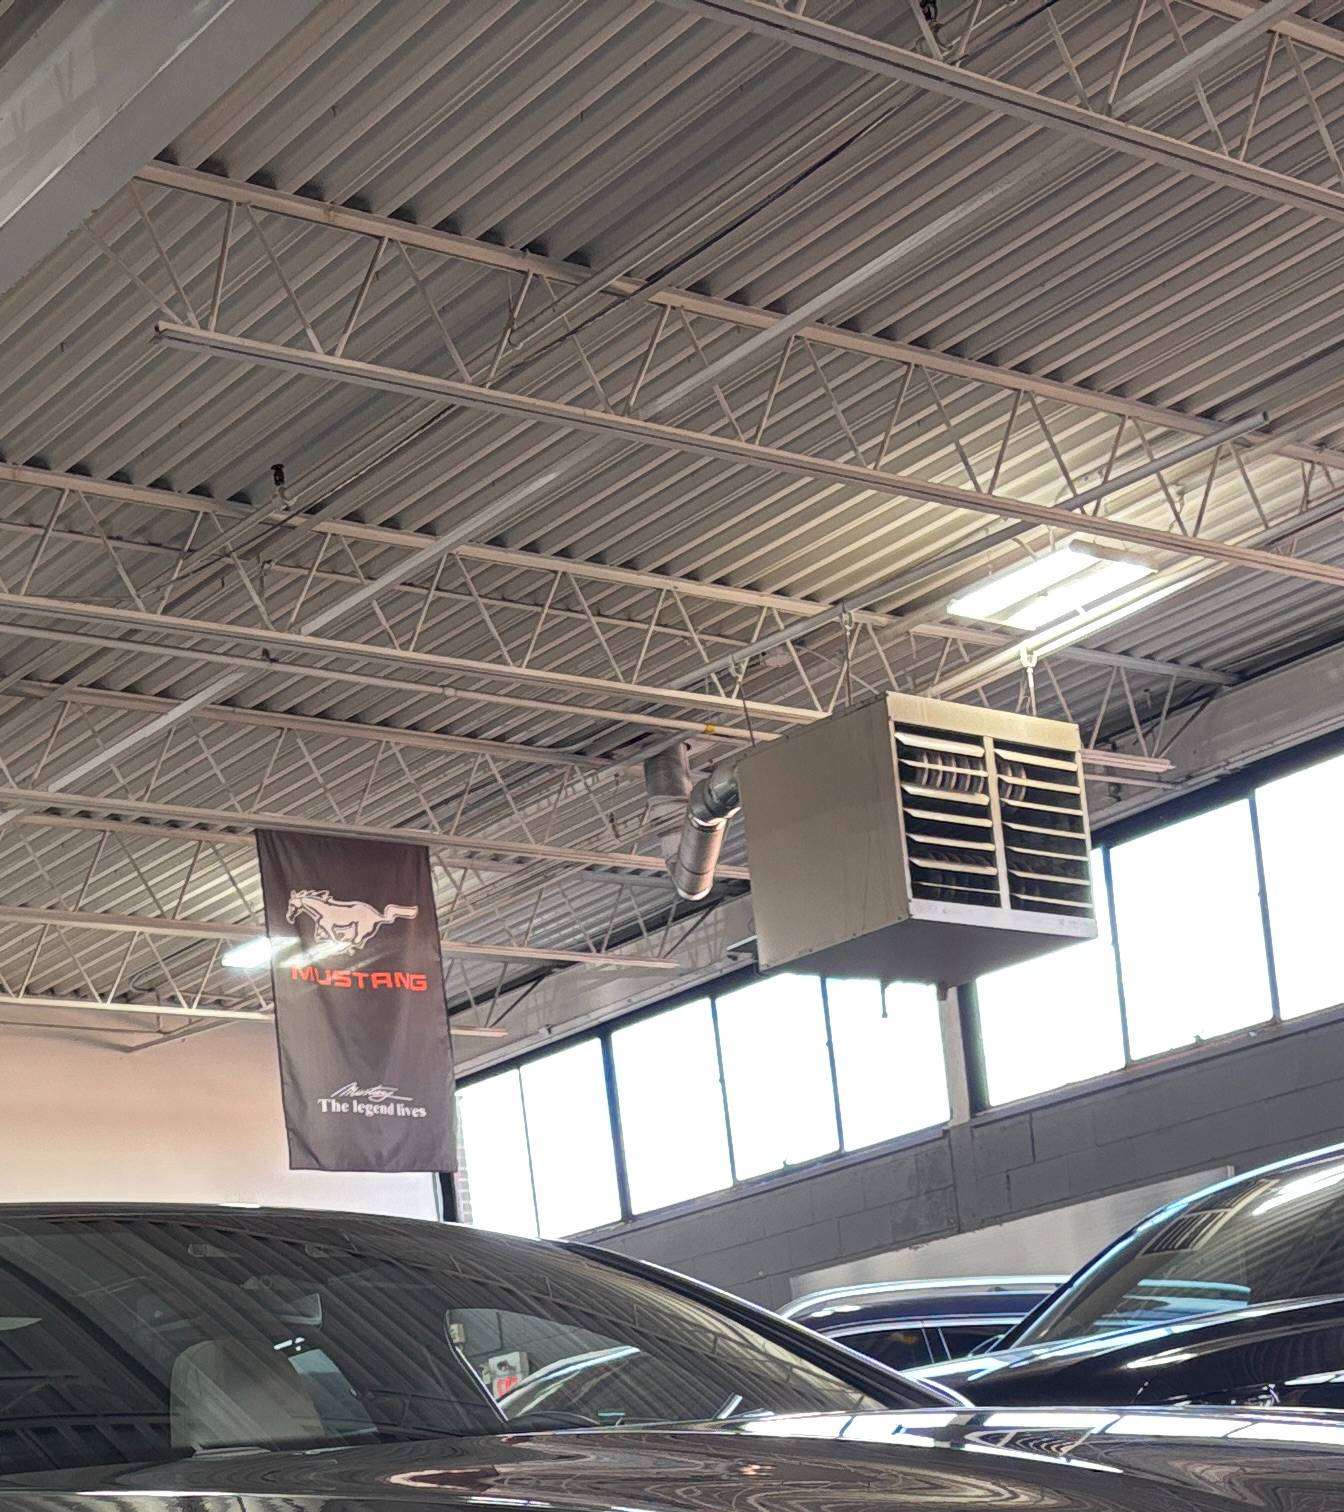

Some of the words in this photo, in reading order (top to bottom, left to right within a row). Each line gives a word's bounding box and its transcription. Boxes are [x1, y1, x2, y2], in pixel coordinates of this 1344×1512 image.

[290, 965, 429, 992] MUSTANG
[317, 1098, 350, 1114] The
[352, 1099, 395, 1118] legend
[396, 1102, 428, 1118] lives
